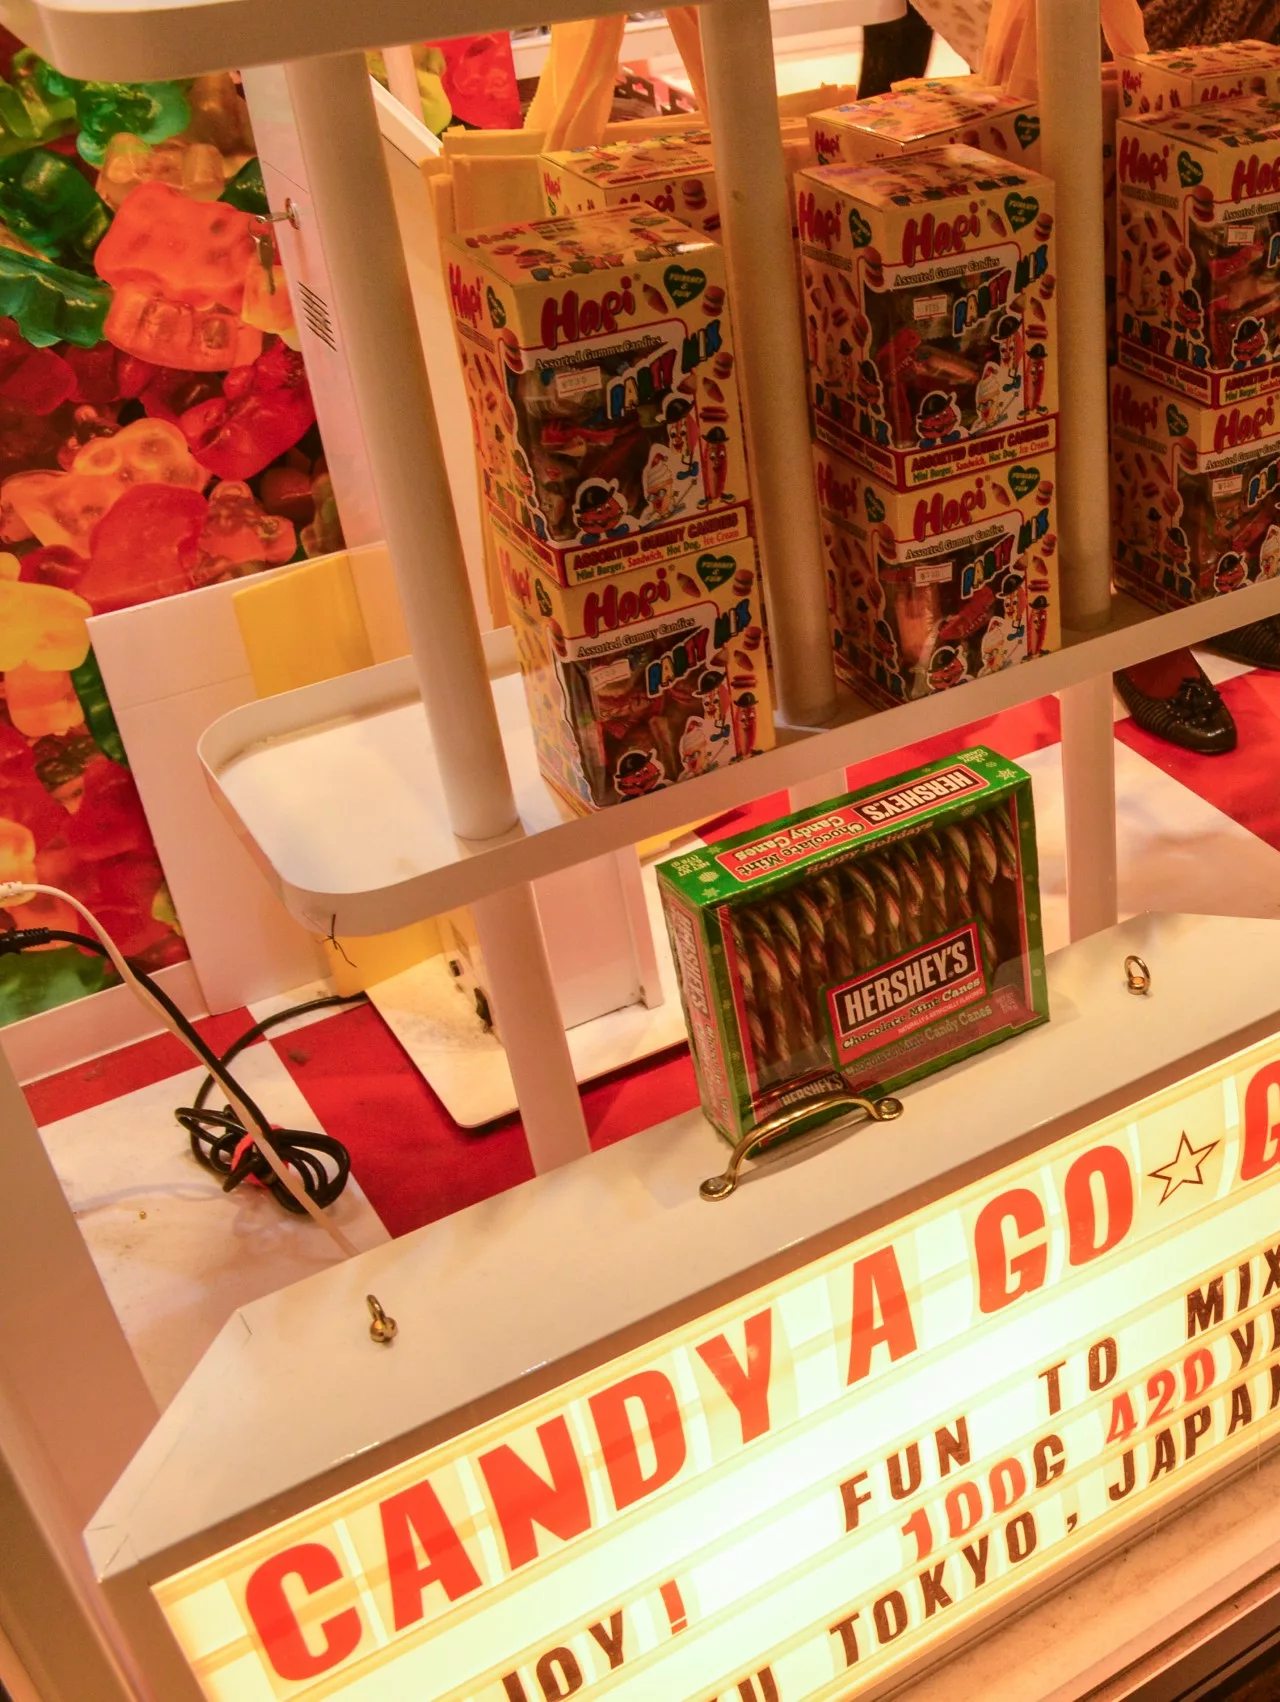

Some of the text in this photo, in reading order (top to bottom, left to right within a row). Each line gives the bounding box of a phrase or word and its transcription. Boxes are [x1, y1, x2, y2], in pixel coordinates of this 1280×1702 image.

[1119, 136, 1169, 190] Hapi
[799, 191, 841, 251] Hapi
[902, 201, 981, 267] Hapi
[449, 262, 482, 329] Hapi
[894, 256, 1000, 286] Assorted Gummy Candies
[954, 270, 1011, 334] PARTY
[540, 276, 635, 350] Hapi
[534, 333, 662, 371] Assorted Gummy Candies
[681, 319, 722, 373] MIX
[609, 350, 677, 419] PARTY
[1214, 396, 1274, 453] Hapi
[914, 477, 986, 542] Hapi
[905, 524, 1004, 560] Assorted Gummy Candies
[963, 535, 1014, 596] PARTY
[584, 568, 670, 638] Hapi
[714, 599, 751, 649] MIX
[577, 618, 695, 657] Assorted Gummy Candies
[647, 628, 709, 695] PARTY
[861, 770, 975, 822] HERSHEY'S
[733, 814, 846, 862] Candy Canes
[734, 852, 782, 877] Mint
[780, 821, 866, 857] Chocolate
[805, 820, 934, 877] Happy Holidays
[676, 914, 709, 1014] HERSHEY'S
[844, 940, 968, 1026] HERSHEY'S
[843, 977, 981, 1049] Chocolate Mint Canes
[846, 1047, 900, 1077] Chocolate
[925, 1016, 958, 1041] Candy
[959, 1005, 993, 1026] Canes
[245, 1307, 772, 1681] CANDY
[847, 1245, 917, 1386] A
[974, 1145, 1133, 1314] GO
[839, 1416, 970, 1533] FUN
[1039, 1336, 1119, 1417] TO
[901, 1433, 1067, 1563] 100G
[829, 1510, 1079, 1668] TOKYO,
